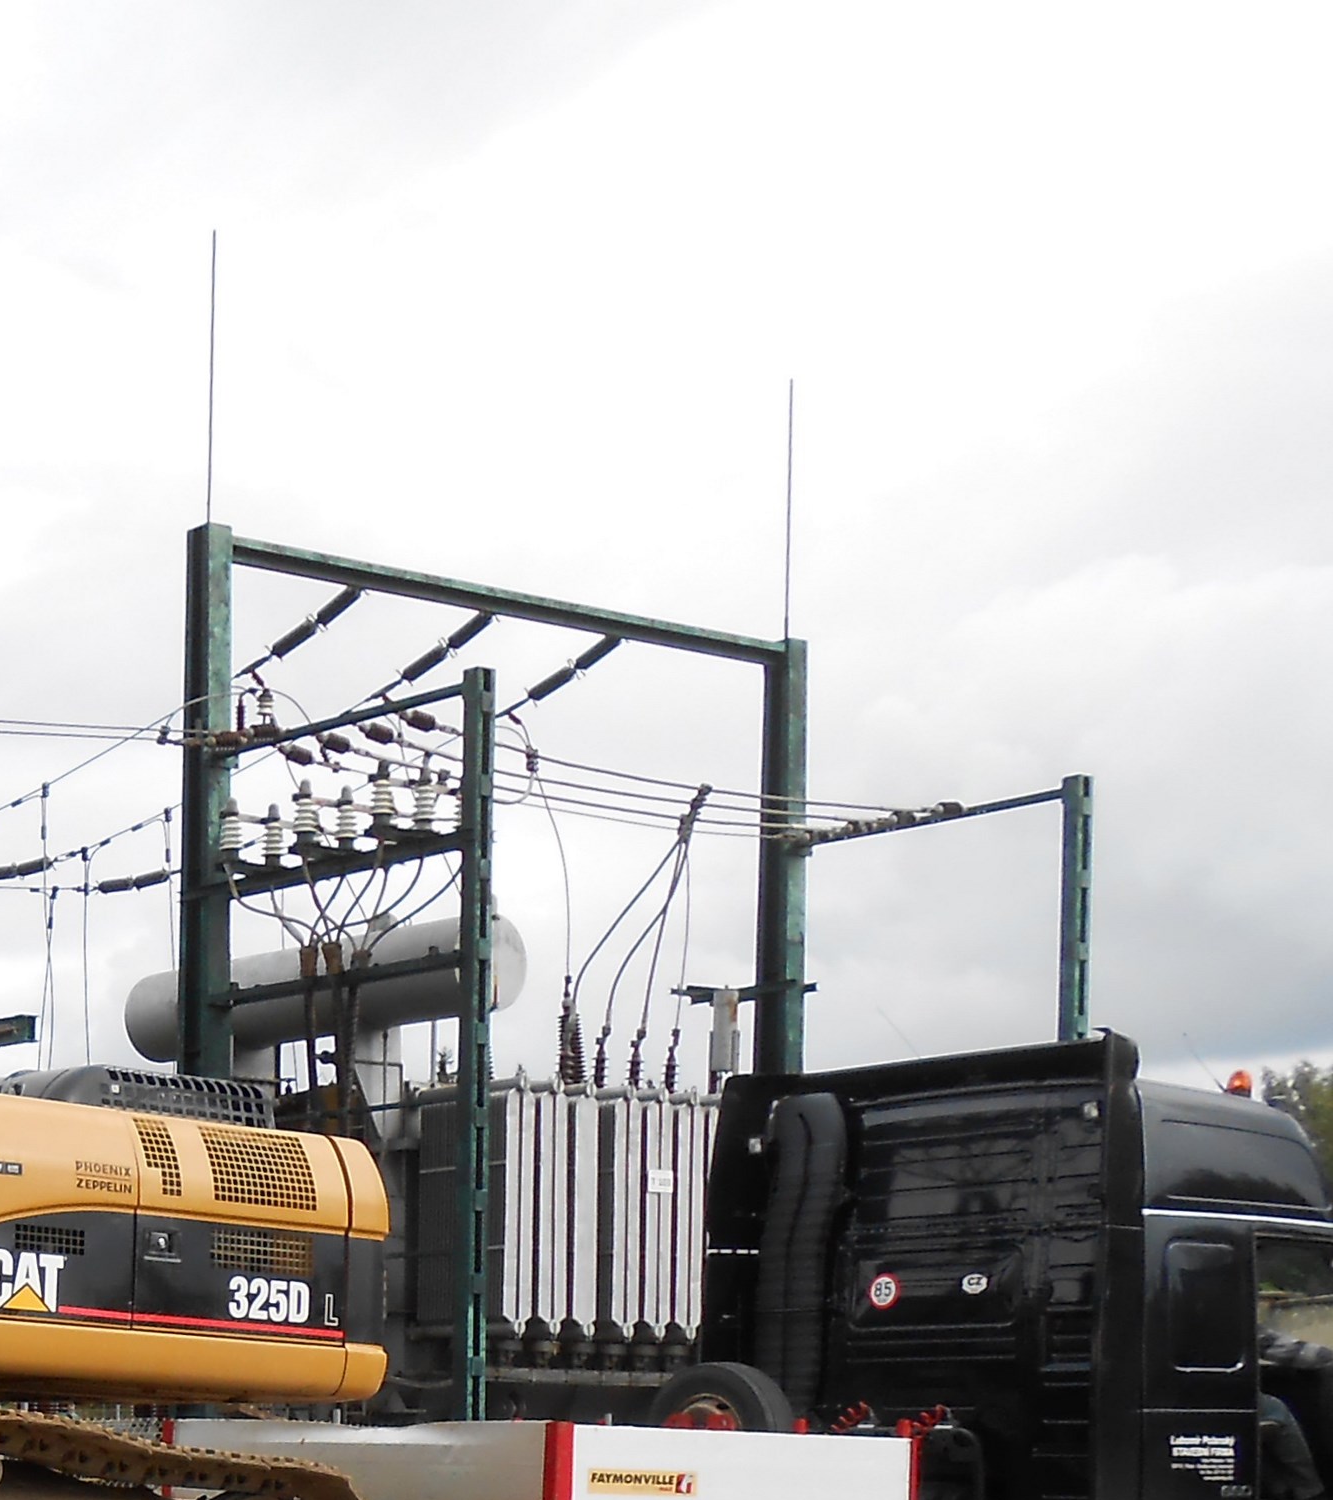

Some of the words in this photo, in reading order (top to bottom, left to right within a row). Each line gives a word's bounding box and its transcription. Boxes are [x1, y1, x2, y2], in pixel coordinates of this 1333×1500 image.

[75, 1160, 131, 1177] PHOENIX
[76, 1177, 133, 1194] ZEPPELIN
[874, 1281, 892, 1297] 85
[967, 1276, 985, 1287] CZ
[228, 1275, 311, 1325] 325D
[323, 1293, 339, 1327] L
[591, 1472, 675, 1486] FAYMONVILLE
